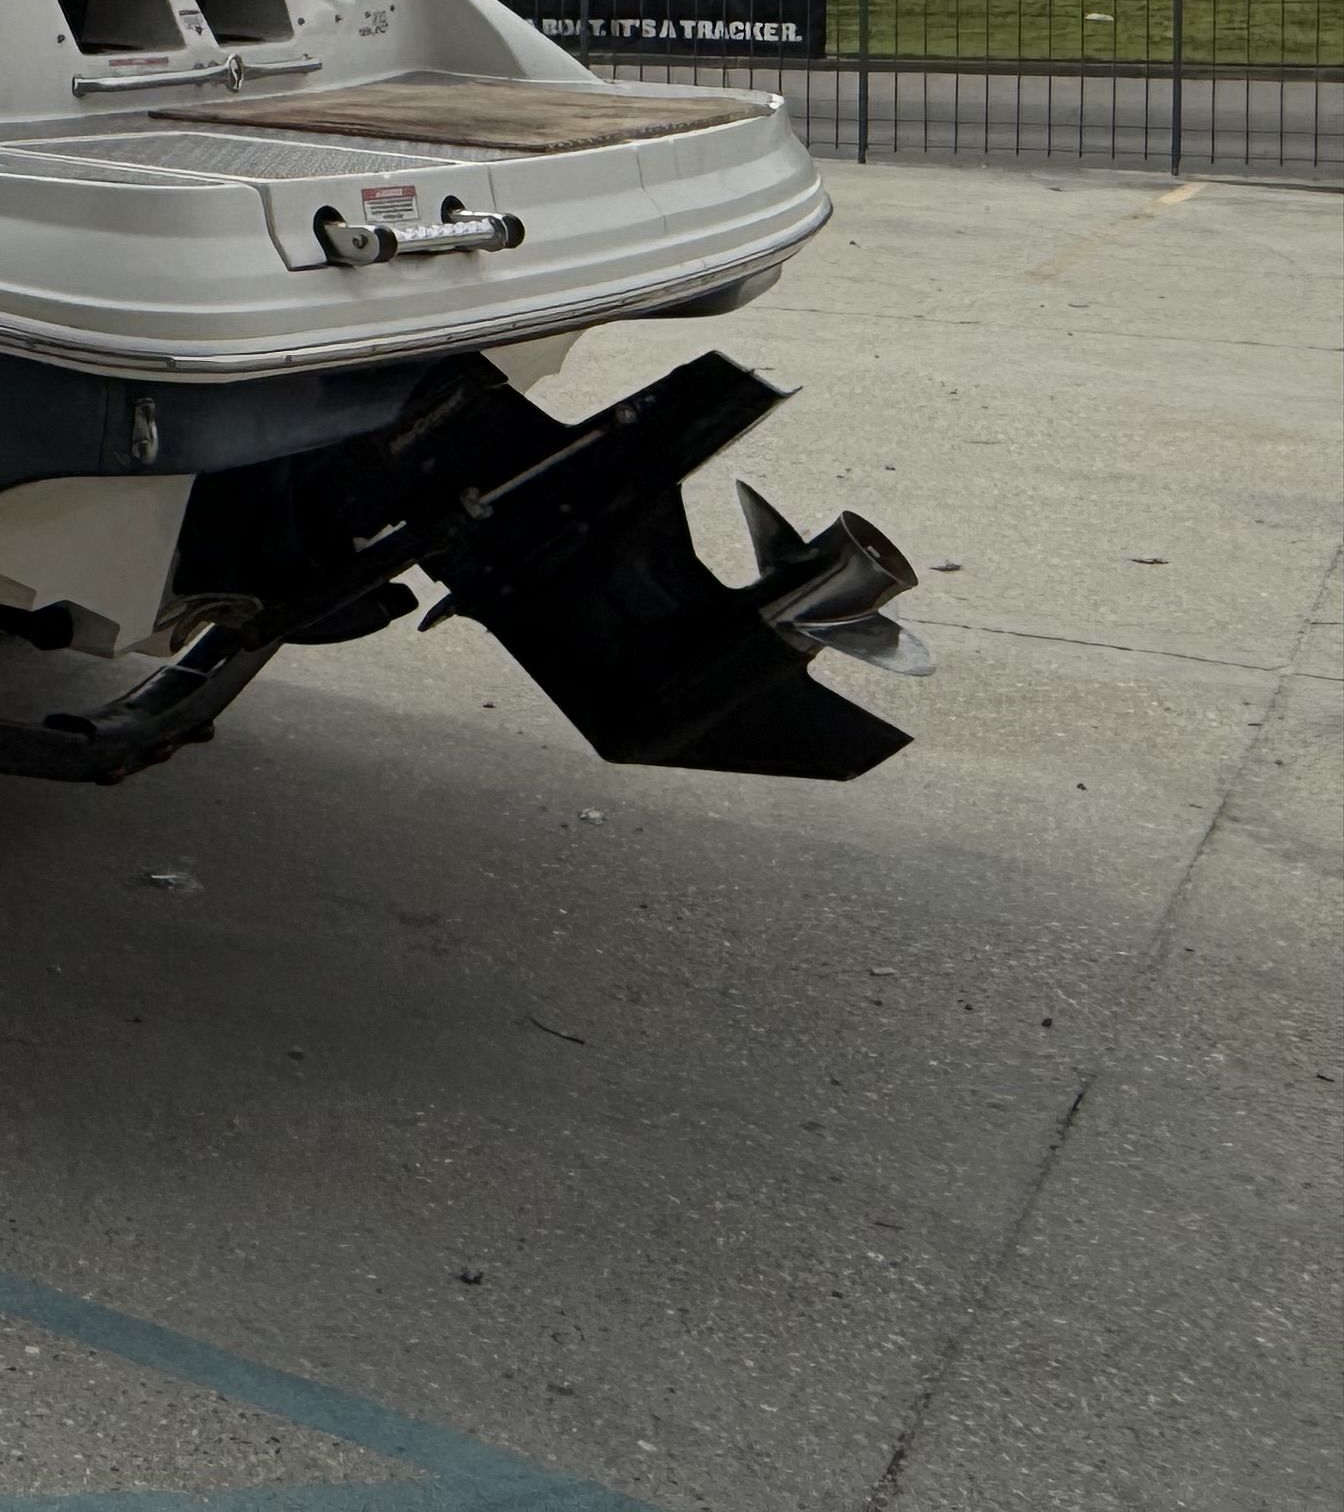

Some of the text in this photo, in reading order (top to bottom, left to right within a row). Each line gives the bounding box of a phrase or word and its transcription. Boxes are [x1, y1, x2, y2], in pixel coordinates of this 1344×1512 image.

[610, 18, 657, 38] IT'S
[659, 19, 677, 39] A
[679, 19, 803, 43] TRACKER.
